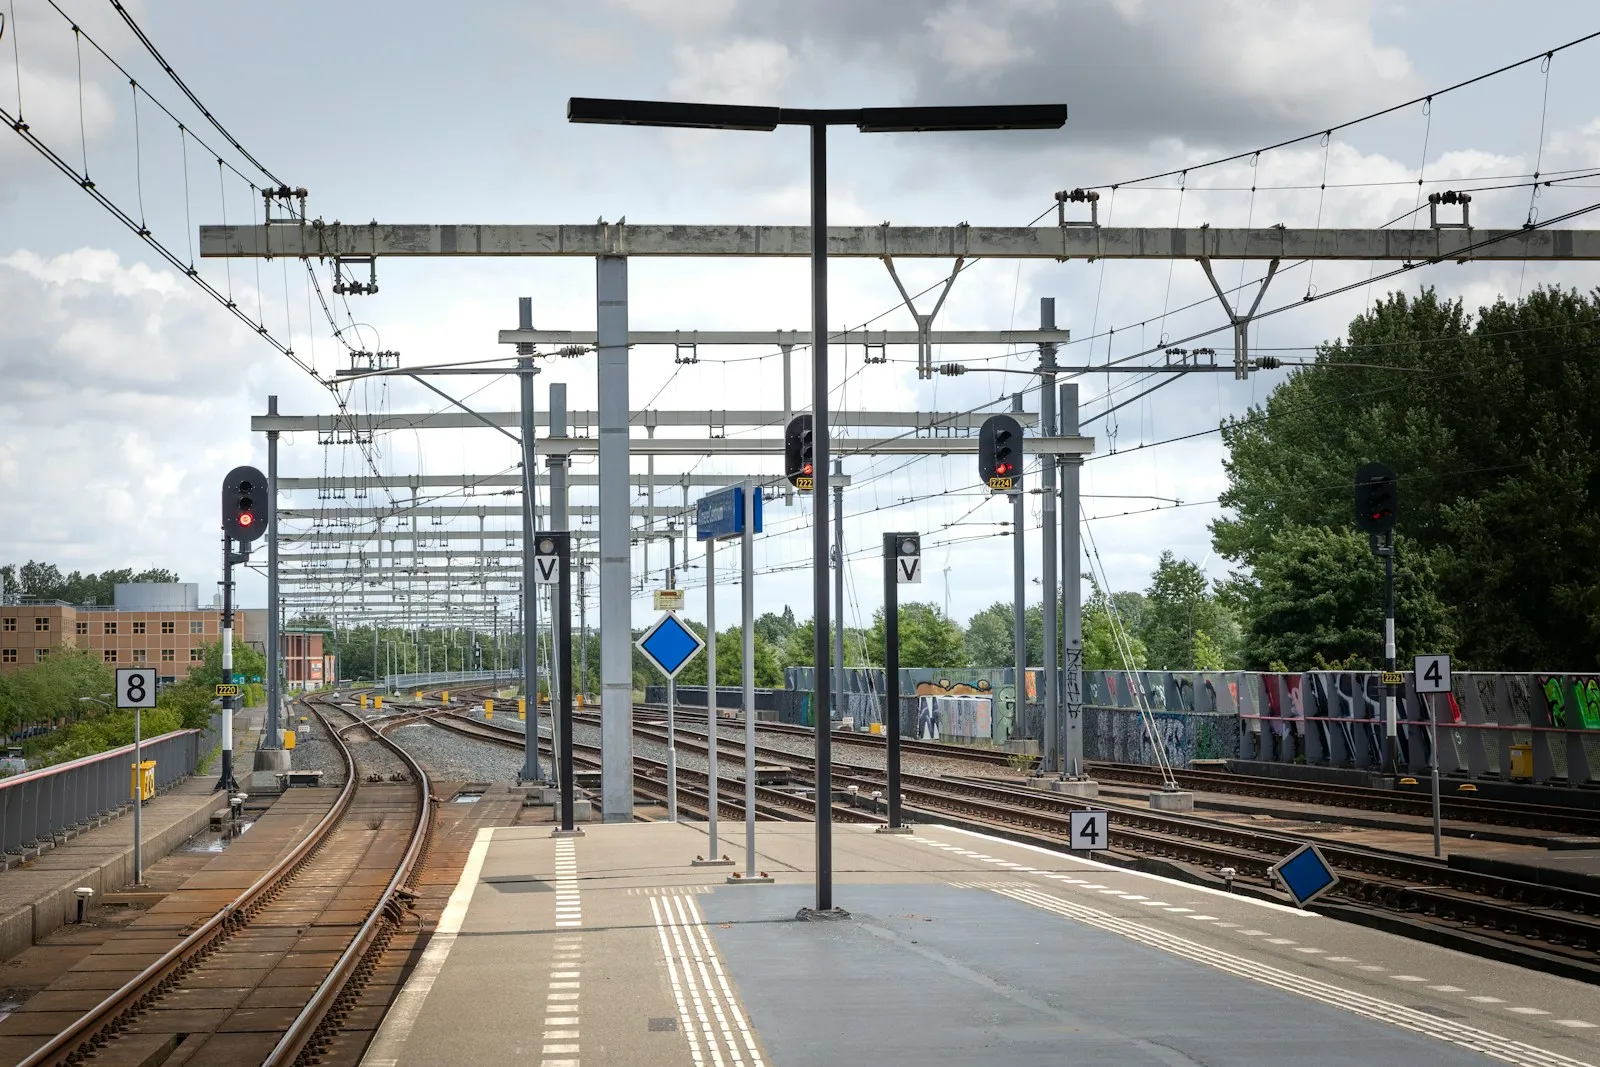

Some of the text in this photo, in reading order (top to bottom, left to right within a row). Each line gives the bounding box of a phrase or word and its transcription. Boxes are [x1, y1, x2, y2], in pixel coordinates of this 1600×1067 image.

[799, 480, 813, 488] 222
[992, 479, 1010, 488] 2224
[537, 558, 557, 581] V
[900, 559, 918, 581] V
[1384, 674, 1401, 682] 2226
[1424, 660, 1442, 688] 4
[127, 674, 145, 702] 8
[218, 686, 236, 694] 2220
[1080, 817, 1099, 845] 4
